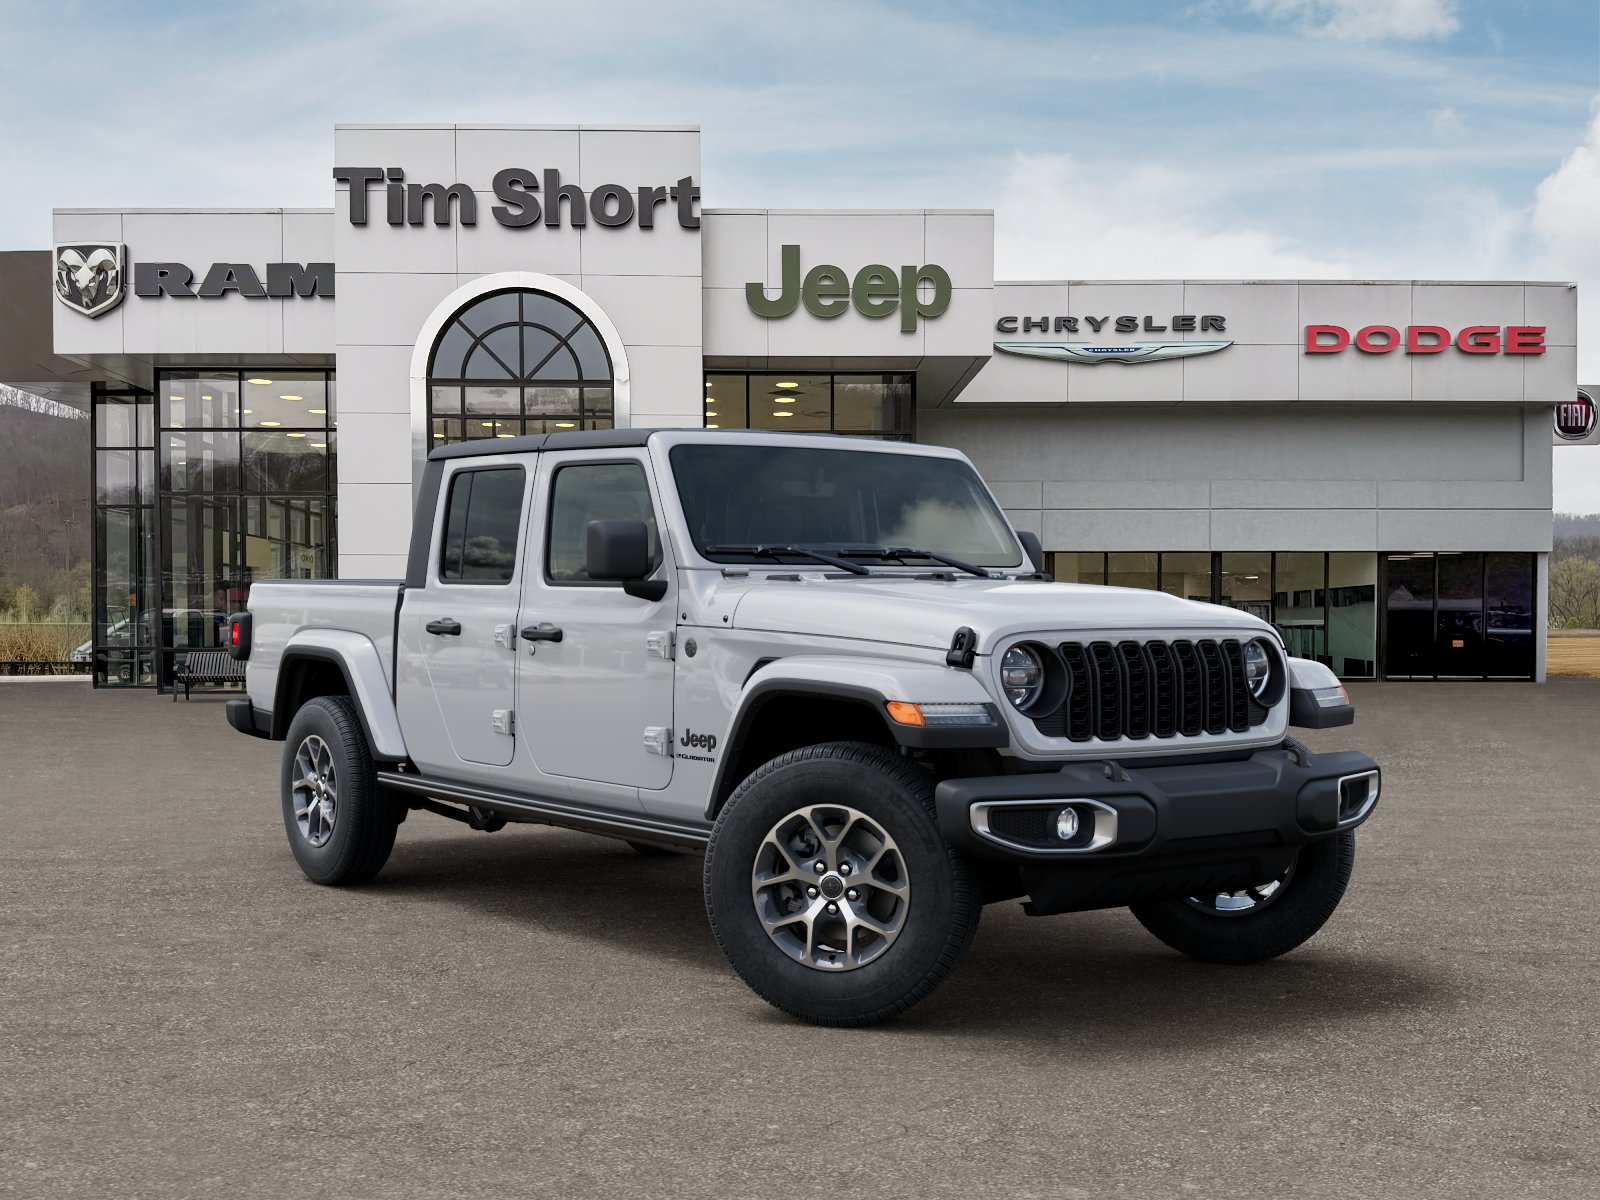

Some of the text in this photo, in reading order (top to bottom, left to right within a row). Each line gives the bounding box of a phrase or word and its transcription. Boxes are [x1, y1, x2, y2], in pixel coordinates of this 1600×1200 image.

[333, 167, 701, 229] Tim Short
[134, 262, 336, 298] RAM
[745, 244, 953, 334] Jeep
[996, 314, 1228, 333] CHRYSLER
[1304, 324, 1547, 355] DODGE
[1559, 404, 1586, 427] FIAT
[681, 728, 717, 752] Jeep
[681, 754, 715, 763] GLADIATOR
